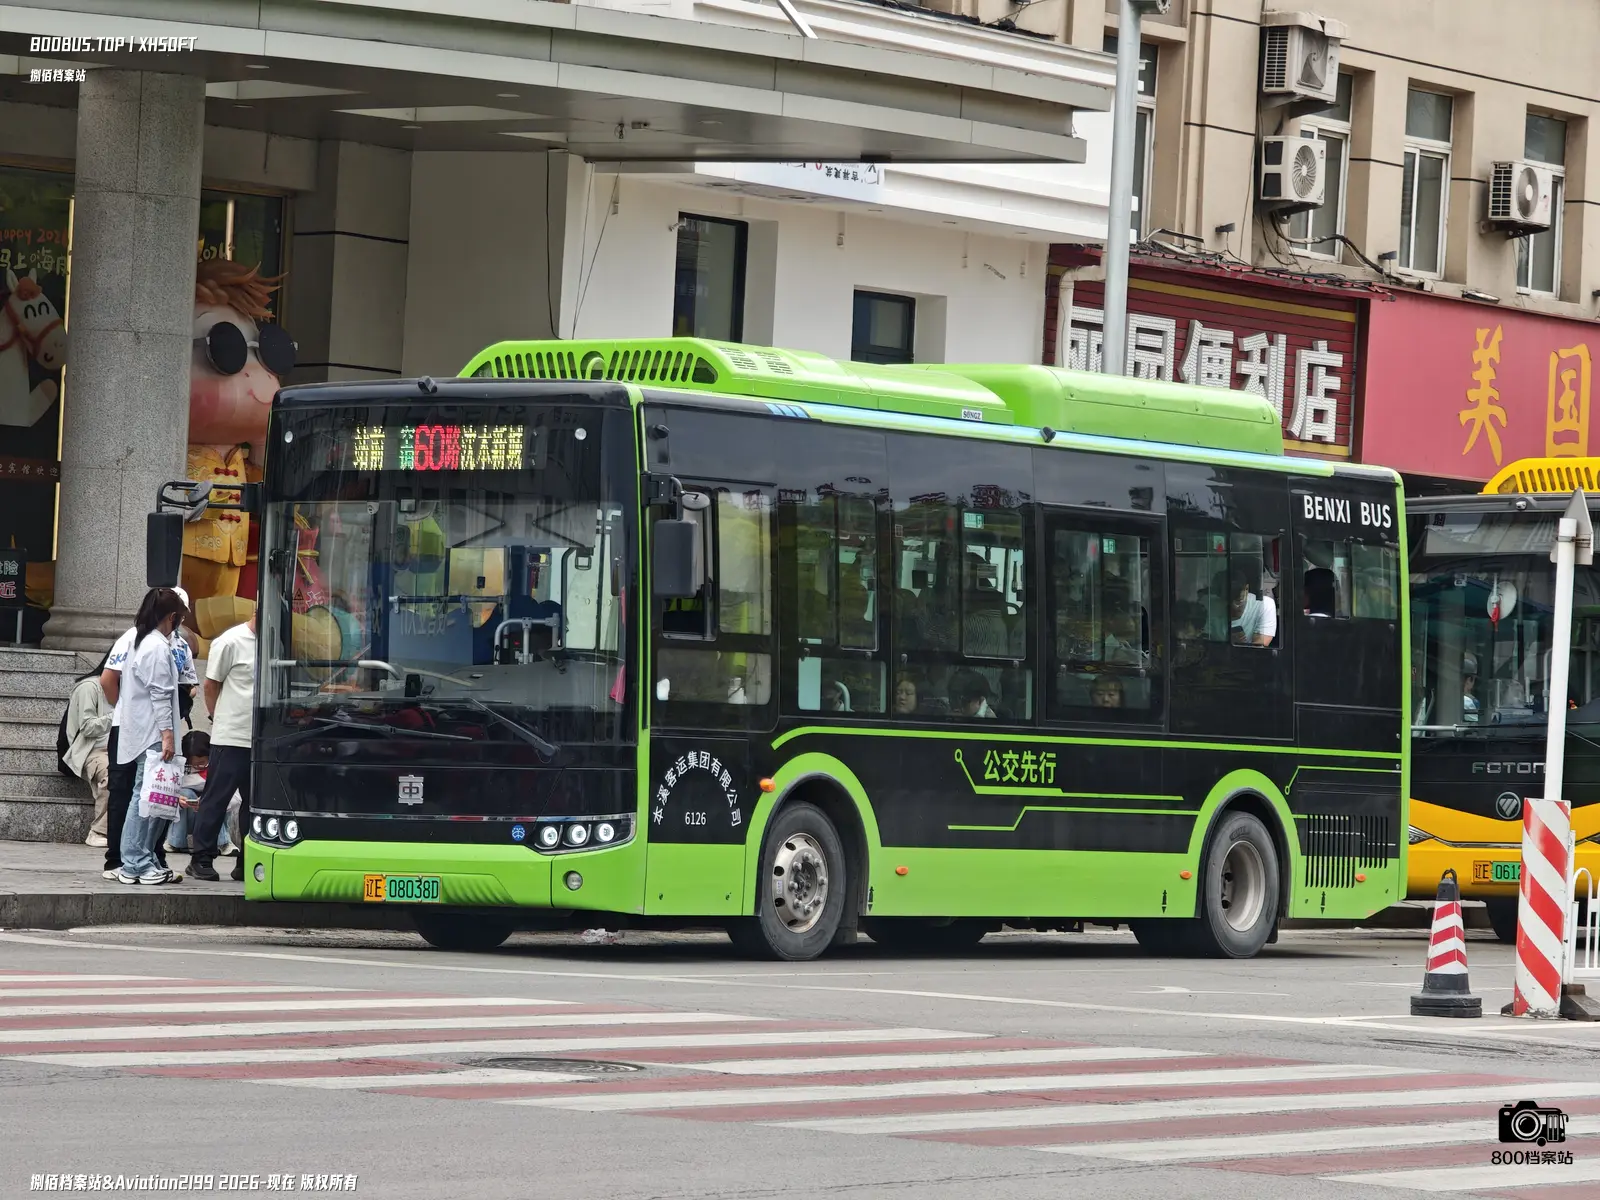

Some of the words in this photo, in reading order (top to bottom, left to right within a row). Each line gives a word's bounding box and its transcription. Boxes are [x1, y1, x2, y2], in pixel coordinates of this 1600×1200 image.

[1303, 495, 1351, 523] BENXI
[1360, 501, 1392, 528] BUS
[983, 749, 1057, 784] 公交先行
[653, 750, 741, 827] 本溪客运集团有限公司
[685, 811, 707, 825] 6126
[389, 879, 439, 899] 08038D
